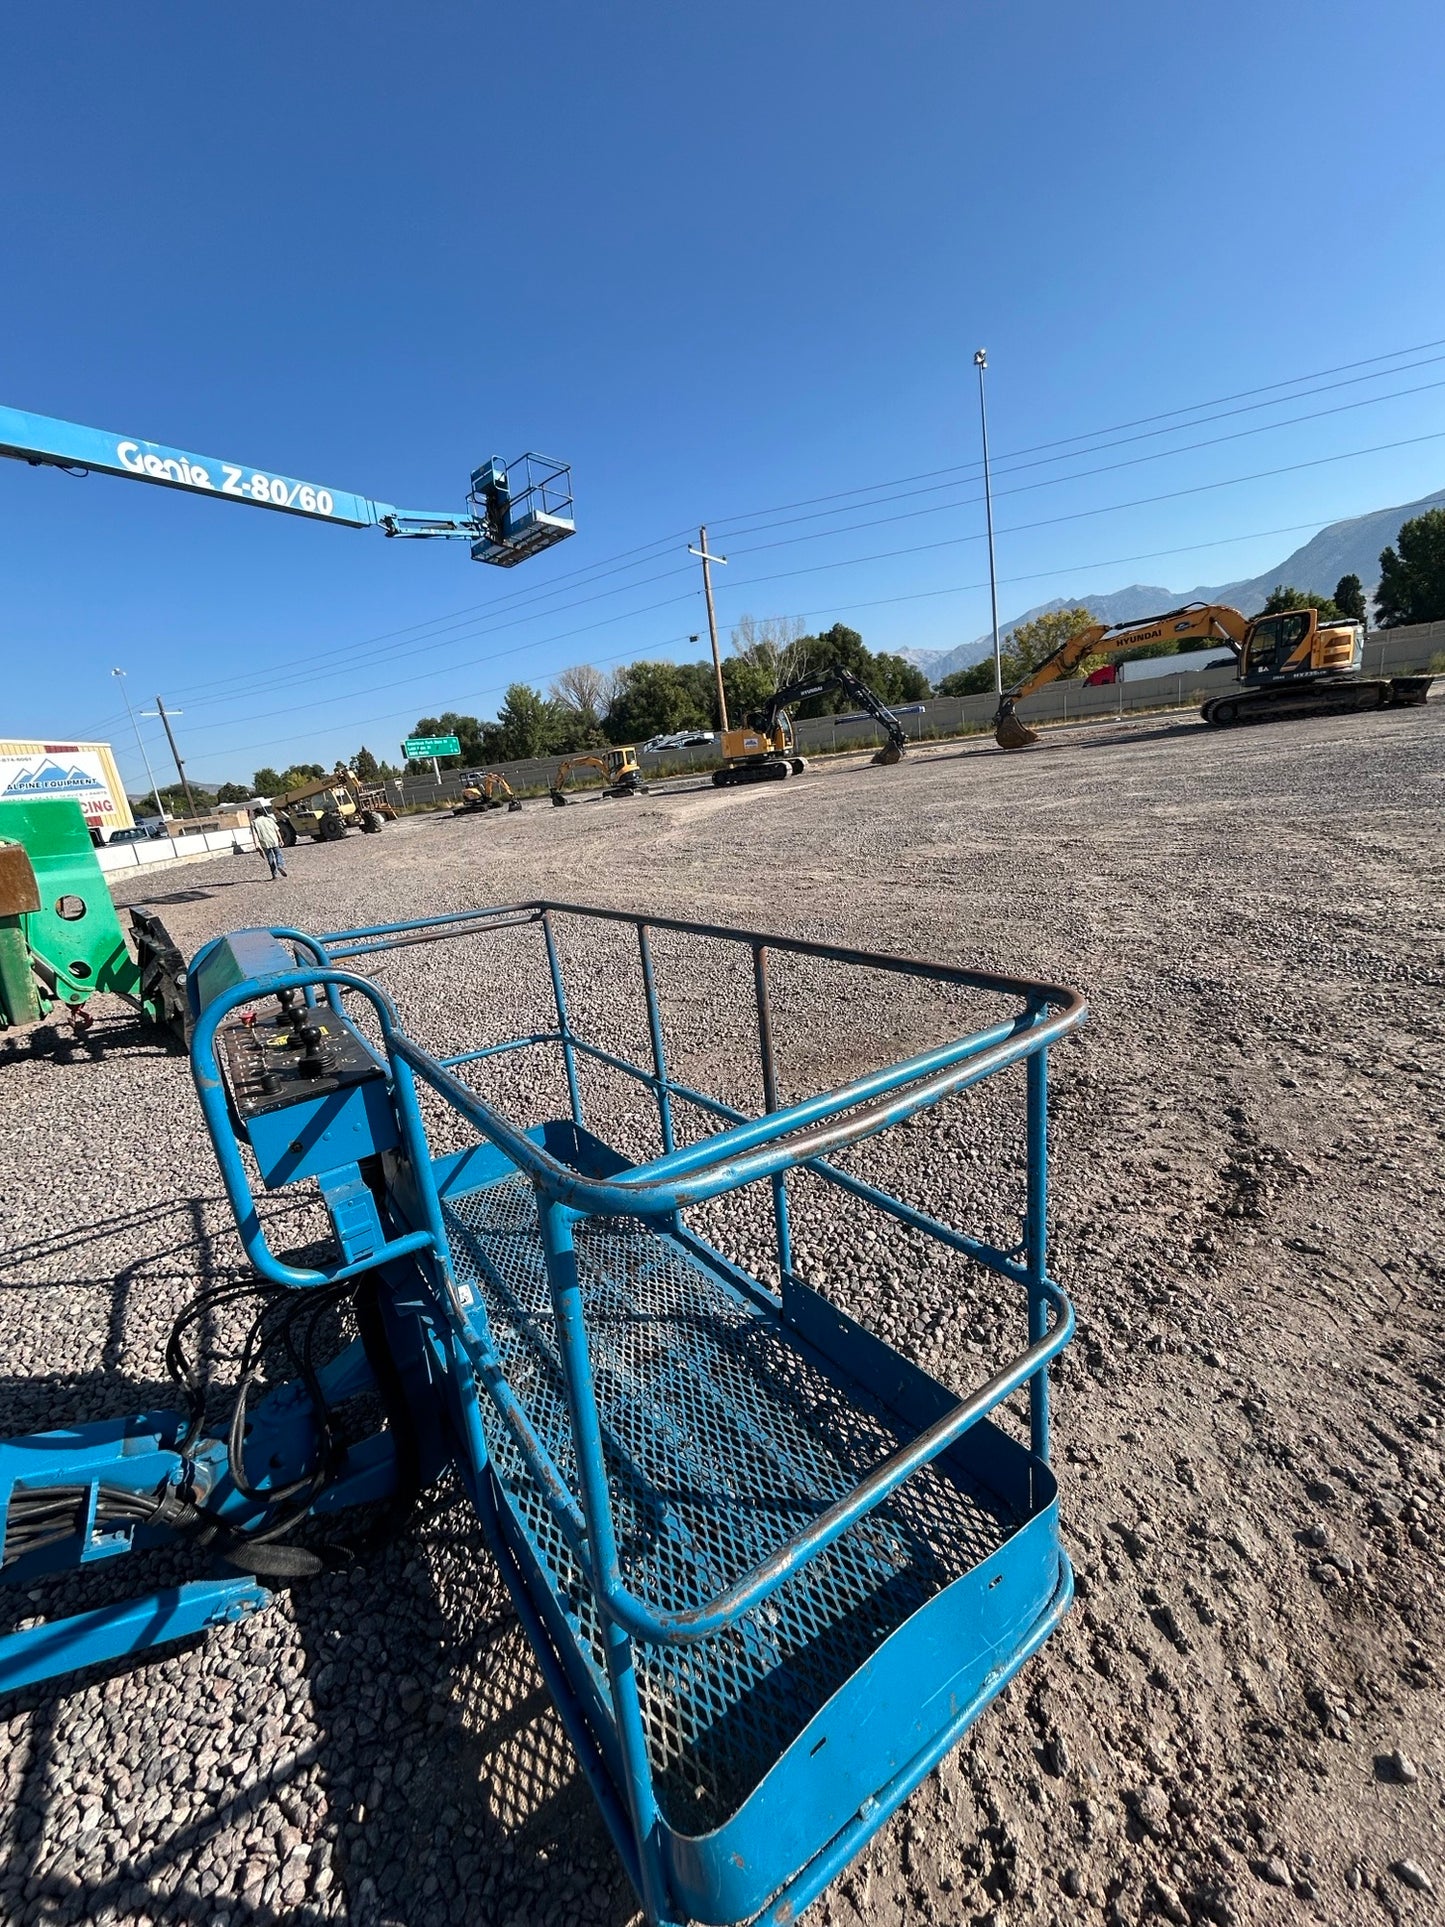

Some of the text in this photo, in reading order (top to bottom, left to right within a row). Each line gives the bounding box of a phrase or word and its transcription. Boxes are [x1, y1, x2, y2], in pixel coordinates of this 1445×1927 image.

[117, 441, 334, 516] Genie Z-80/60
[1116, 629, 1162, 647] HYUNDAI
[7, 778, 97, 791] ALPINE EQUIPMENT
